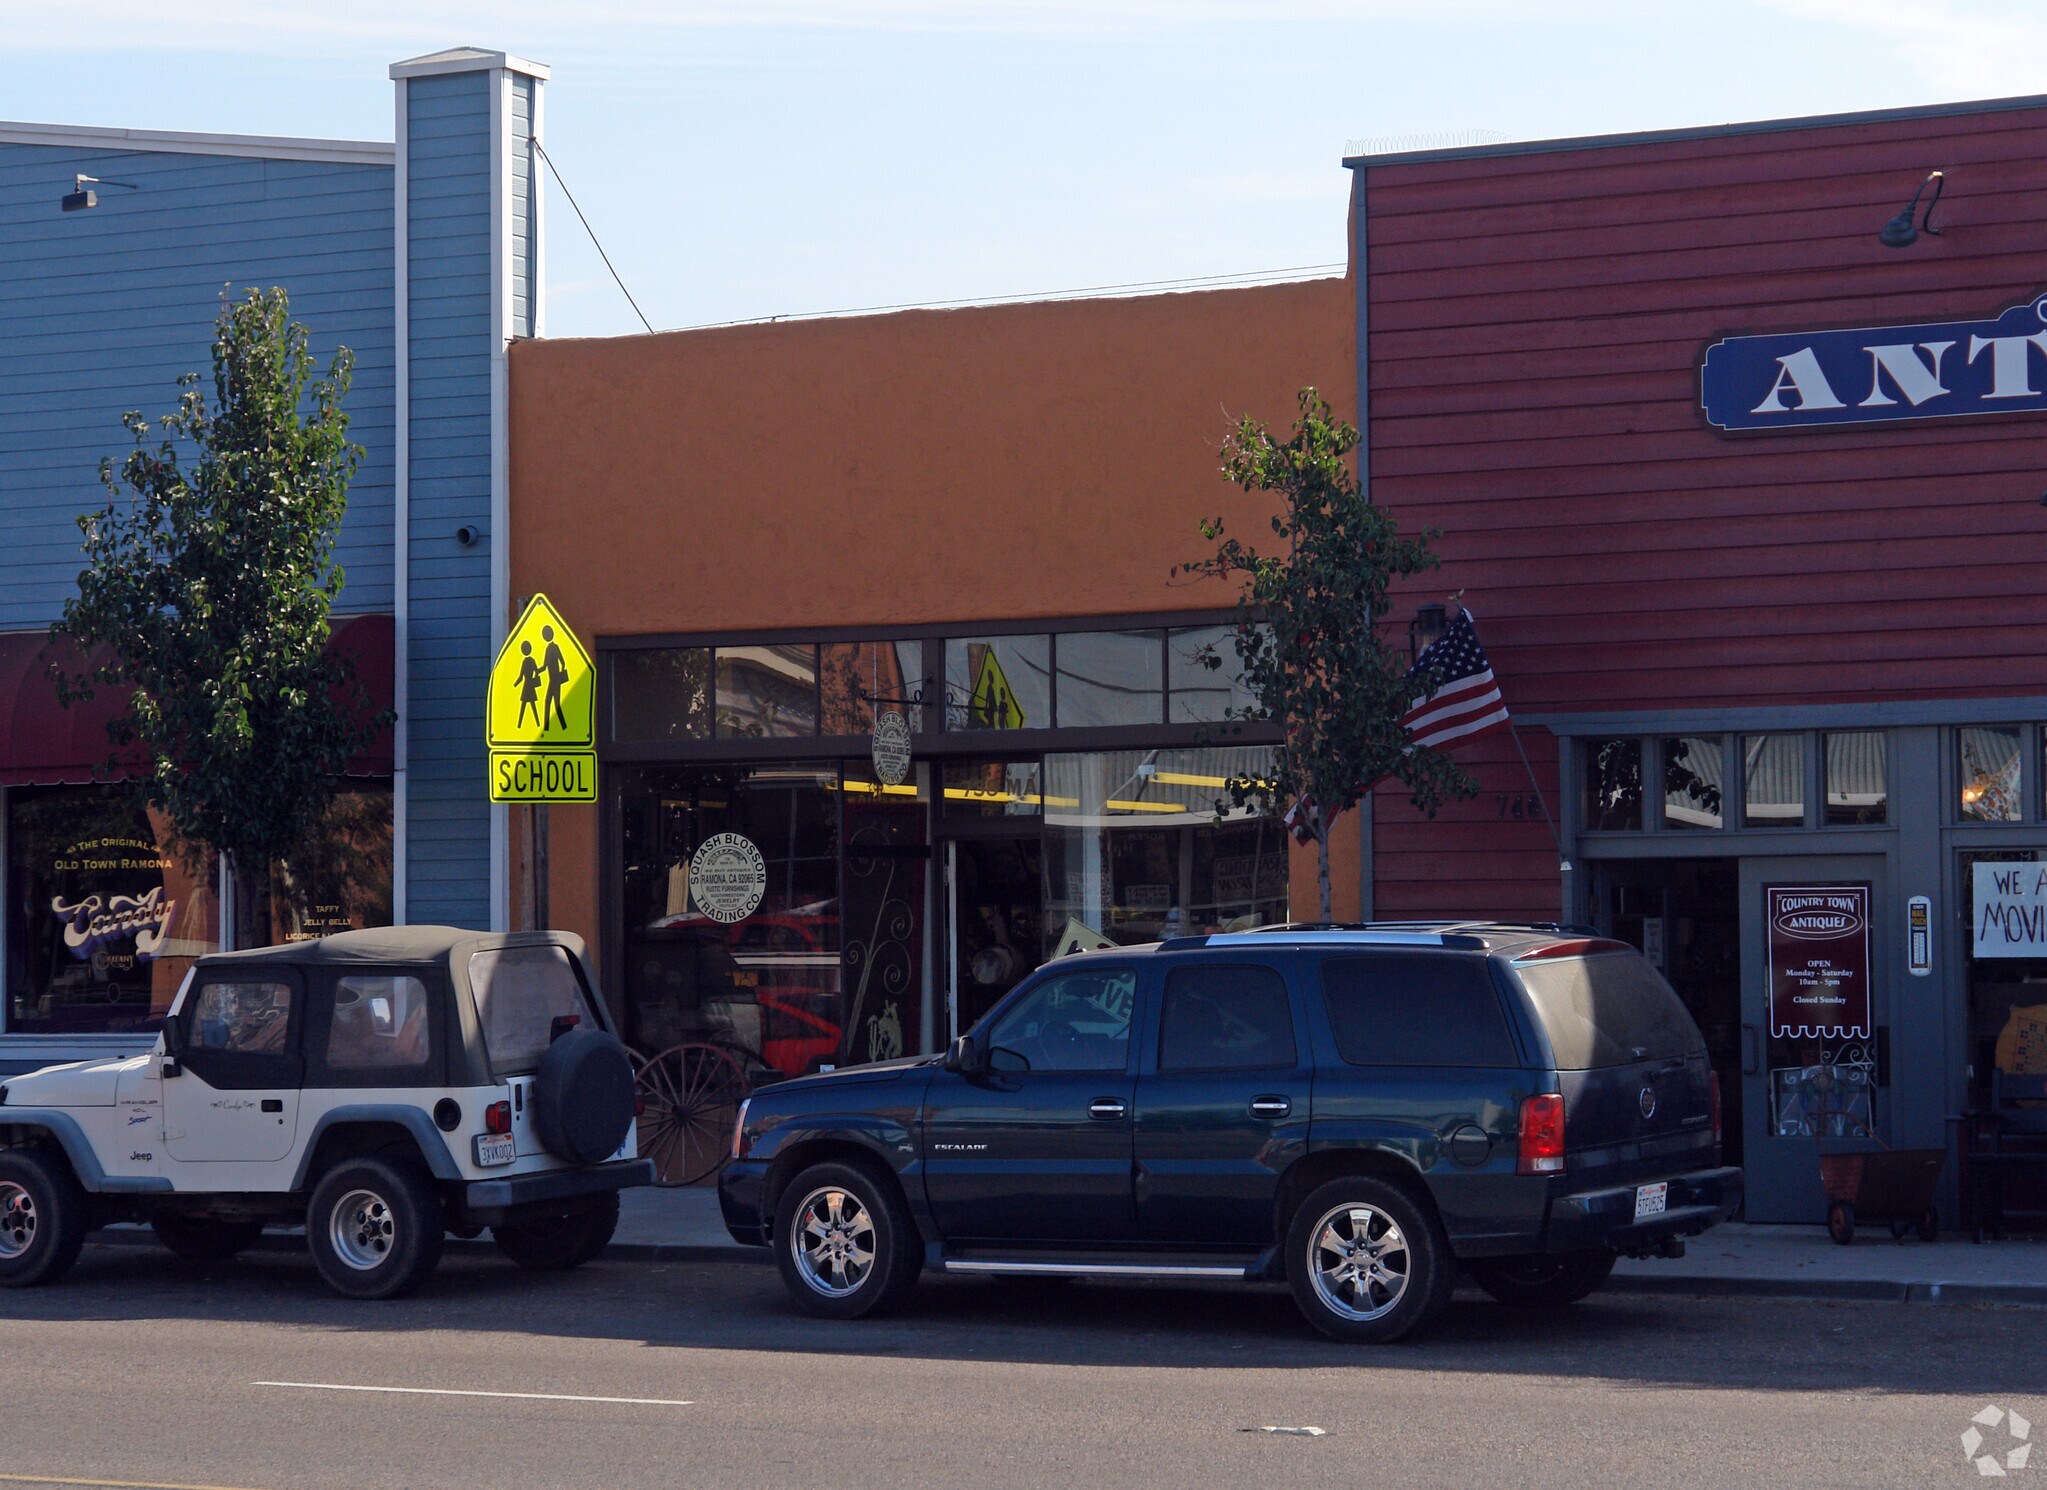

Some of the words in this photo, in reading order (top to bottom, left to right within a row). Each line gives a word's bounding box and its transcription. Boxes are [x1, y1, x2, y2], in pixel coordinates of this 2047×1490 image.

[1751, 328, 2047, 412] ANT
[499, 760, 588, 792] SCHOOL
[78, 840, 98, 850] THE
[101, 838, 149, 851] ORIGINAL
[54, 860, 79, 870] OLD
[83, 860, 116, 869] TOWN
[121, 859, 172, 869] RAMONA
[691, 836, 721, 884] SQUASH
[725, 834, 765, 884] BLOSSOM
[729, 874, 737, 884] CA
[1993, 870, 2022, 895] WE
[696, 894, 746, 922] TRADING
[746, 892, 761, 911] CO.
[1782, 898, 1824, 912] COUNTRY
[1827, 897, 1854, 912] TOWN
[52, 886, 176, 958] Candy
[1790, 917, 1846, 929] ANTIQUES
[1980, 902, 2044, 943] MOVI
[130, 1151, 152, 1161] Jeep
[481, 1144, 513, 1161] 3XVK002
